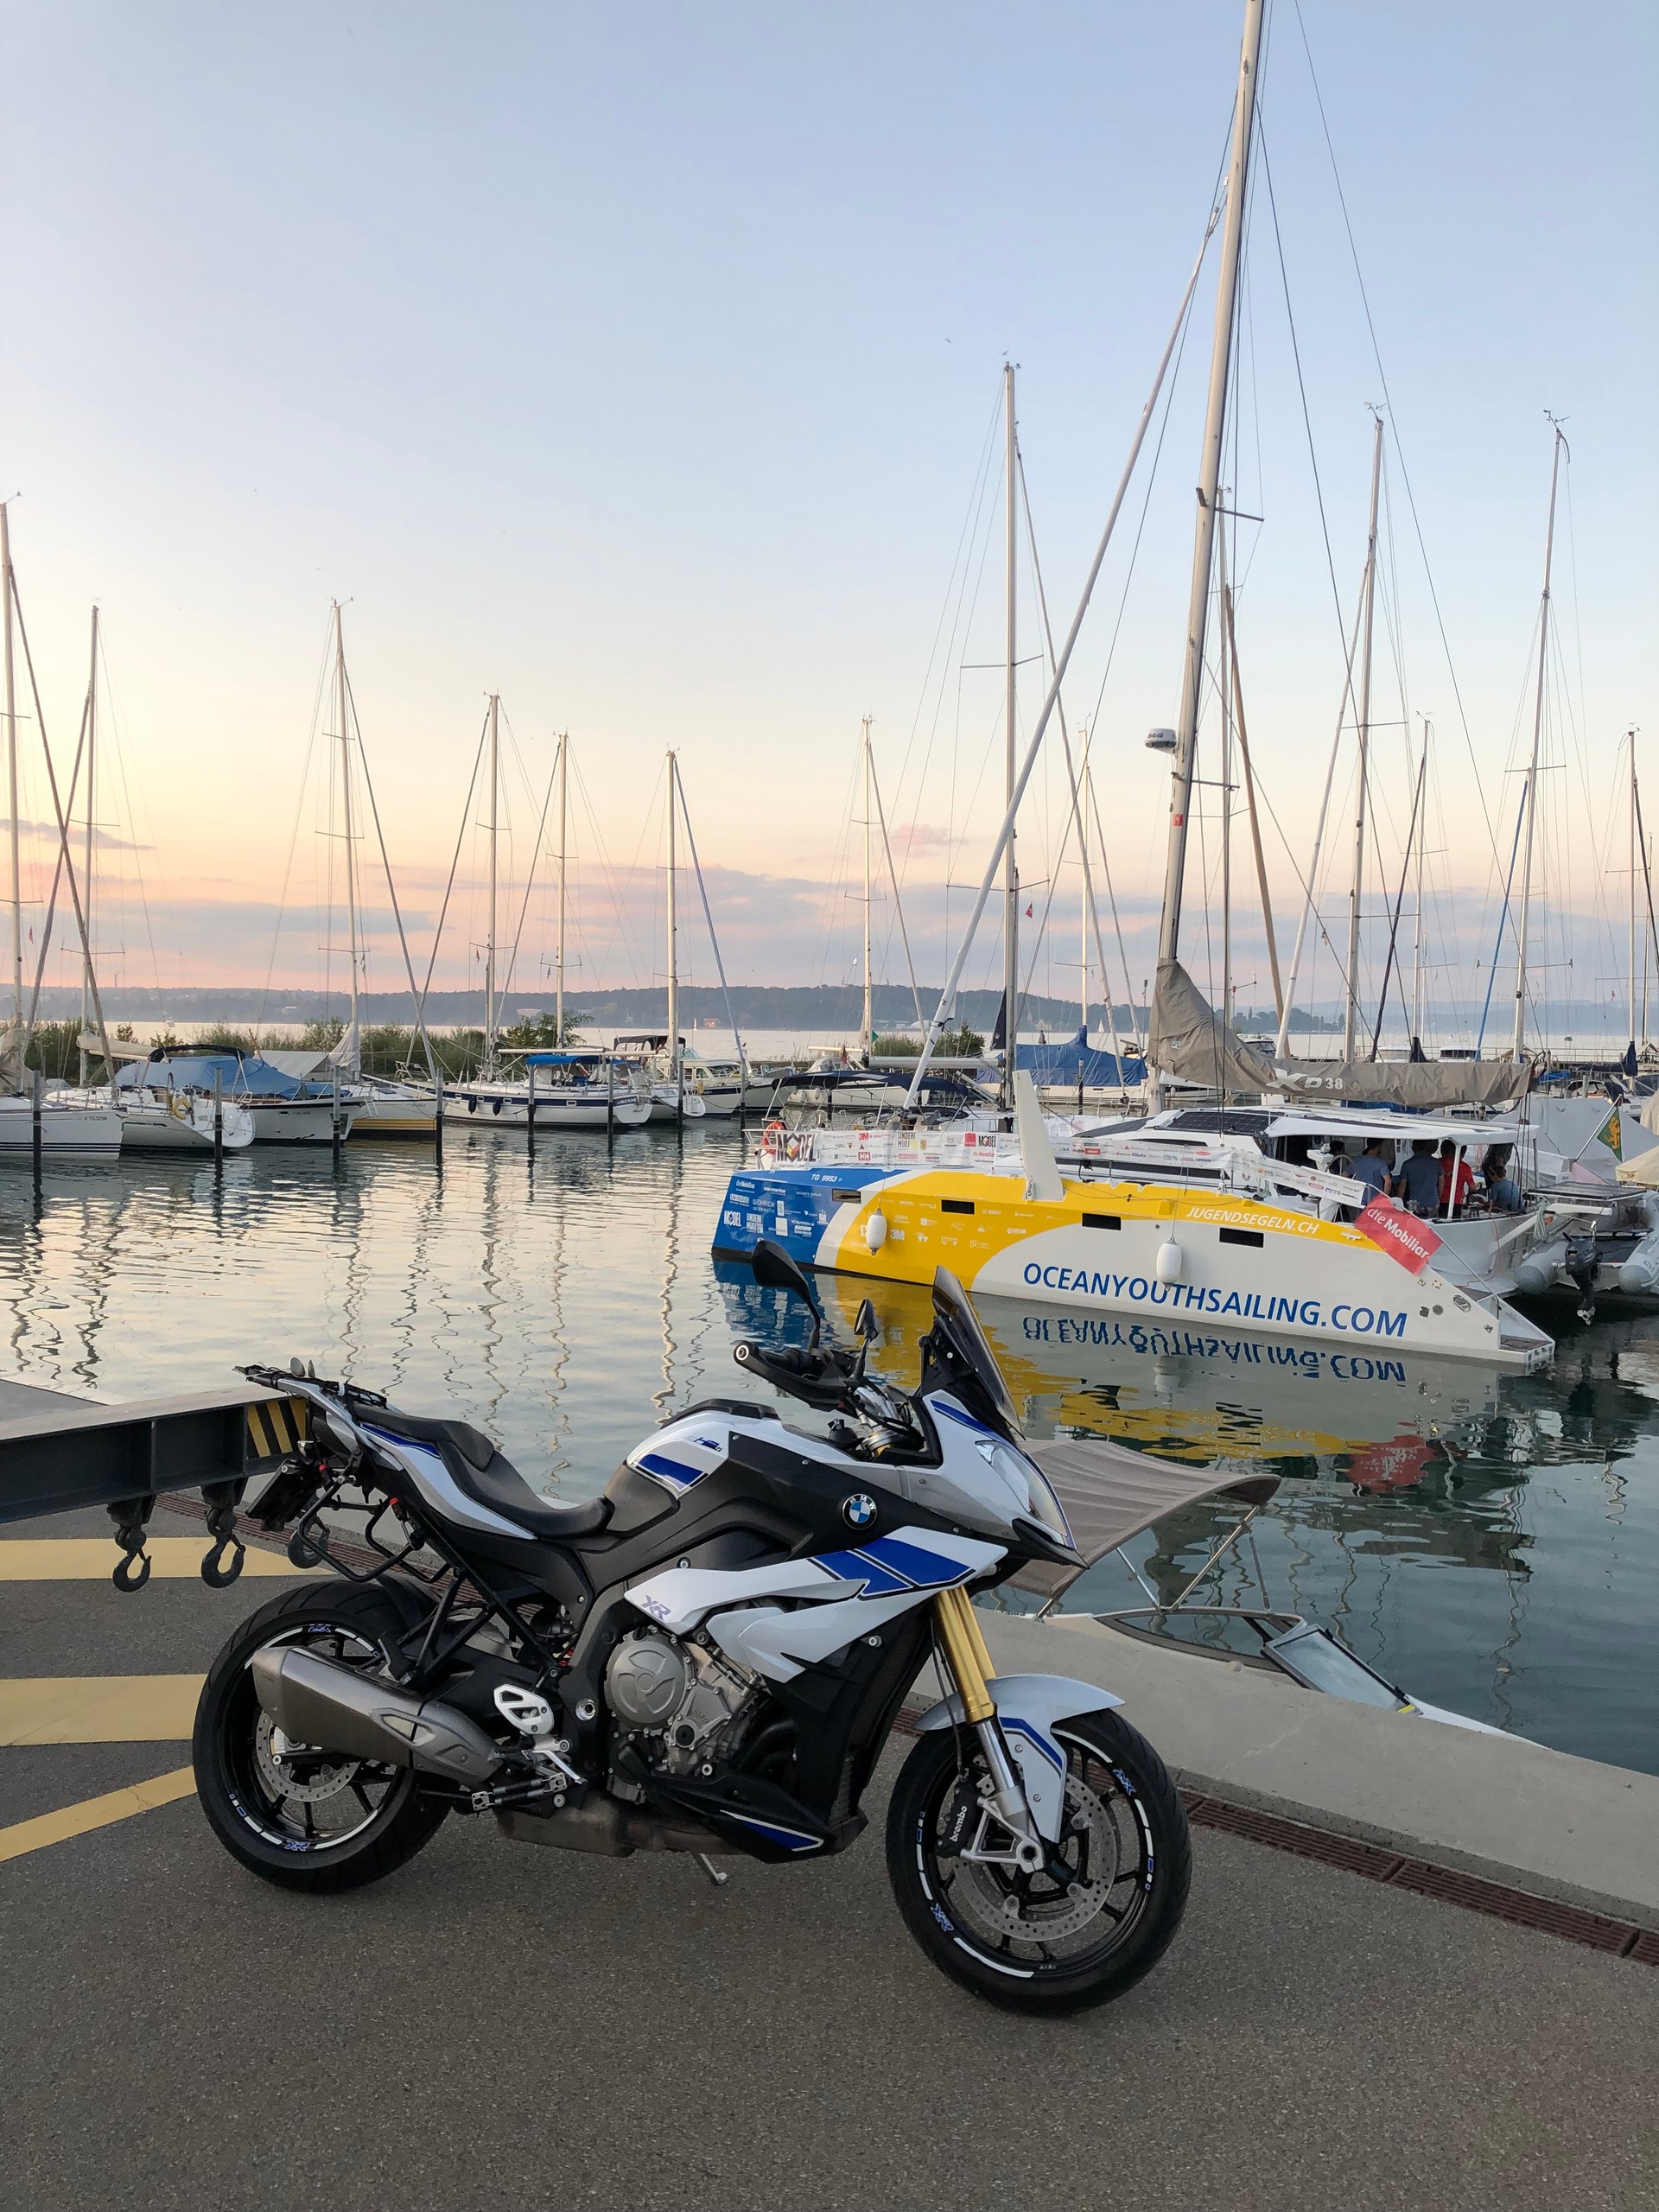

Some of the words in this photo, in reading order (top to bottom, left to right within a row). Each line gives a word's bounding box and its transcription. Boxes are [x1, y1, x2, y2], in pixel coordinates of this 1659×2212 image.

[1325, 1077, 1344, 1090] 38
[858, 1132, 869, 1141] 3M
[978, 1135, 996, 1147] MODEL
[1186, 1207, 1319, 1234] JUGENDSEGELN.CH
[1367, 1208, 1386, 1224] die
[1383, 1217, 1429, 1259] Mobiliar
[891, 1229, 905, 1241] 3M
[1023, 1262, 1408, 1338] OCEANYOUTHSAILING.COM
[640, 1594, 671, 1621] XR
[949, 1806, 968, 1842] brembo
